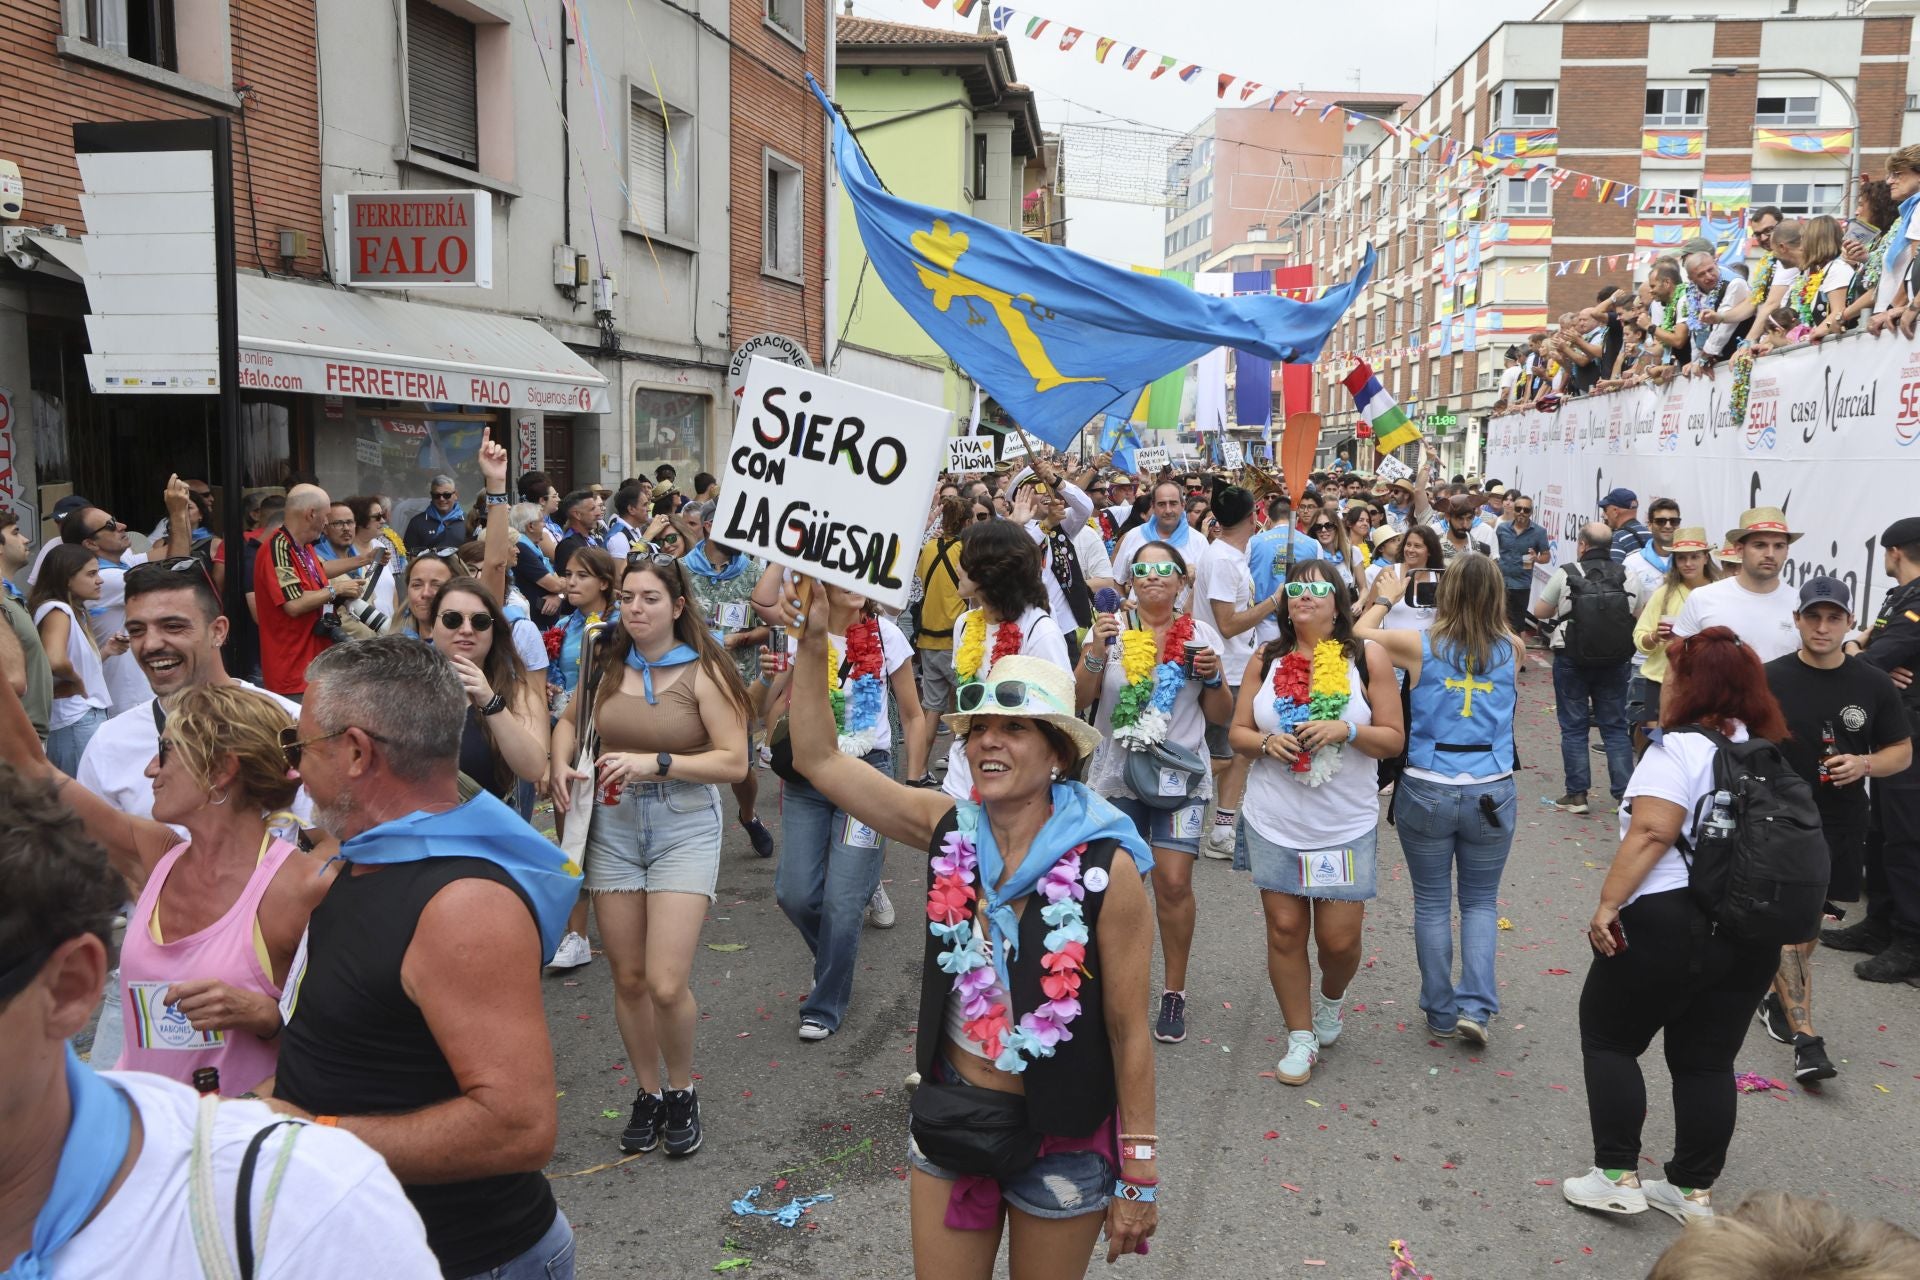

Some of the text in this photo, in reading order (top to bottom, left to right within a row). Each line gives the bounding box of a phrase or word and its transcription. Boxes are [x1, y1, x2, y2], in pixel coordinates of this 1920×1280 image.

[356, 196, 467, 227] FERRETERÍA
[356, 235, 468, 275] FALO
[244, 352, 273, 367] online
[731, 335, 806, 376] DECORACIONE
[326, 363, 448, 400] FERRETERIA
[471, 378, 511, 405] FALO
[1748, 400, 1777, 429] SELLA
[1791, 400, 1817, 423] casa
[1803, 365, 1878, 443] Marcial
[1428, 415, 1456, 425] 11:08
[1660, 413, 1681, 436] SELLA
[1688, 413, 1704, 431] casa
[731, 446, 786, 486] CON
[724, 491, 902, 590] LA GÜESAL
